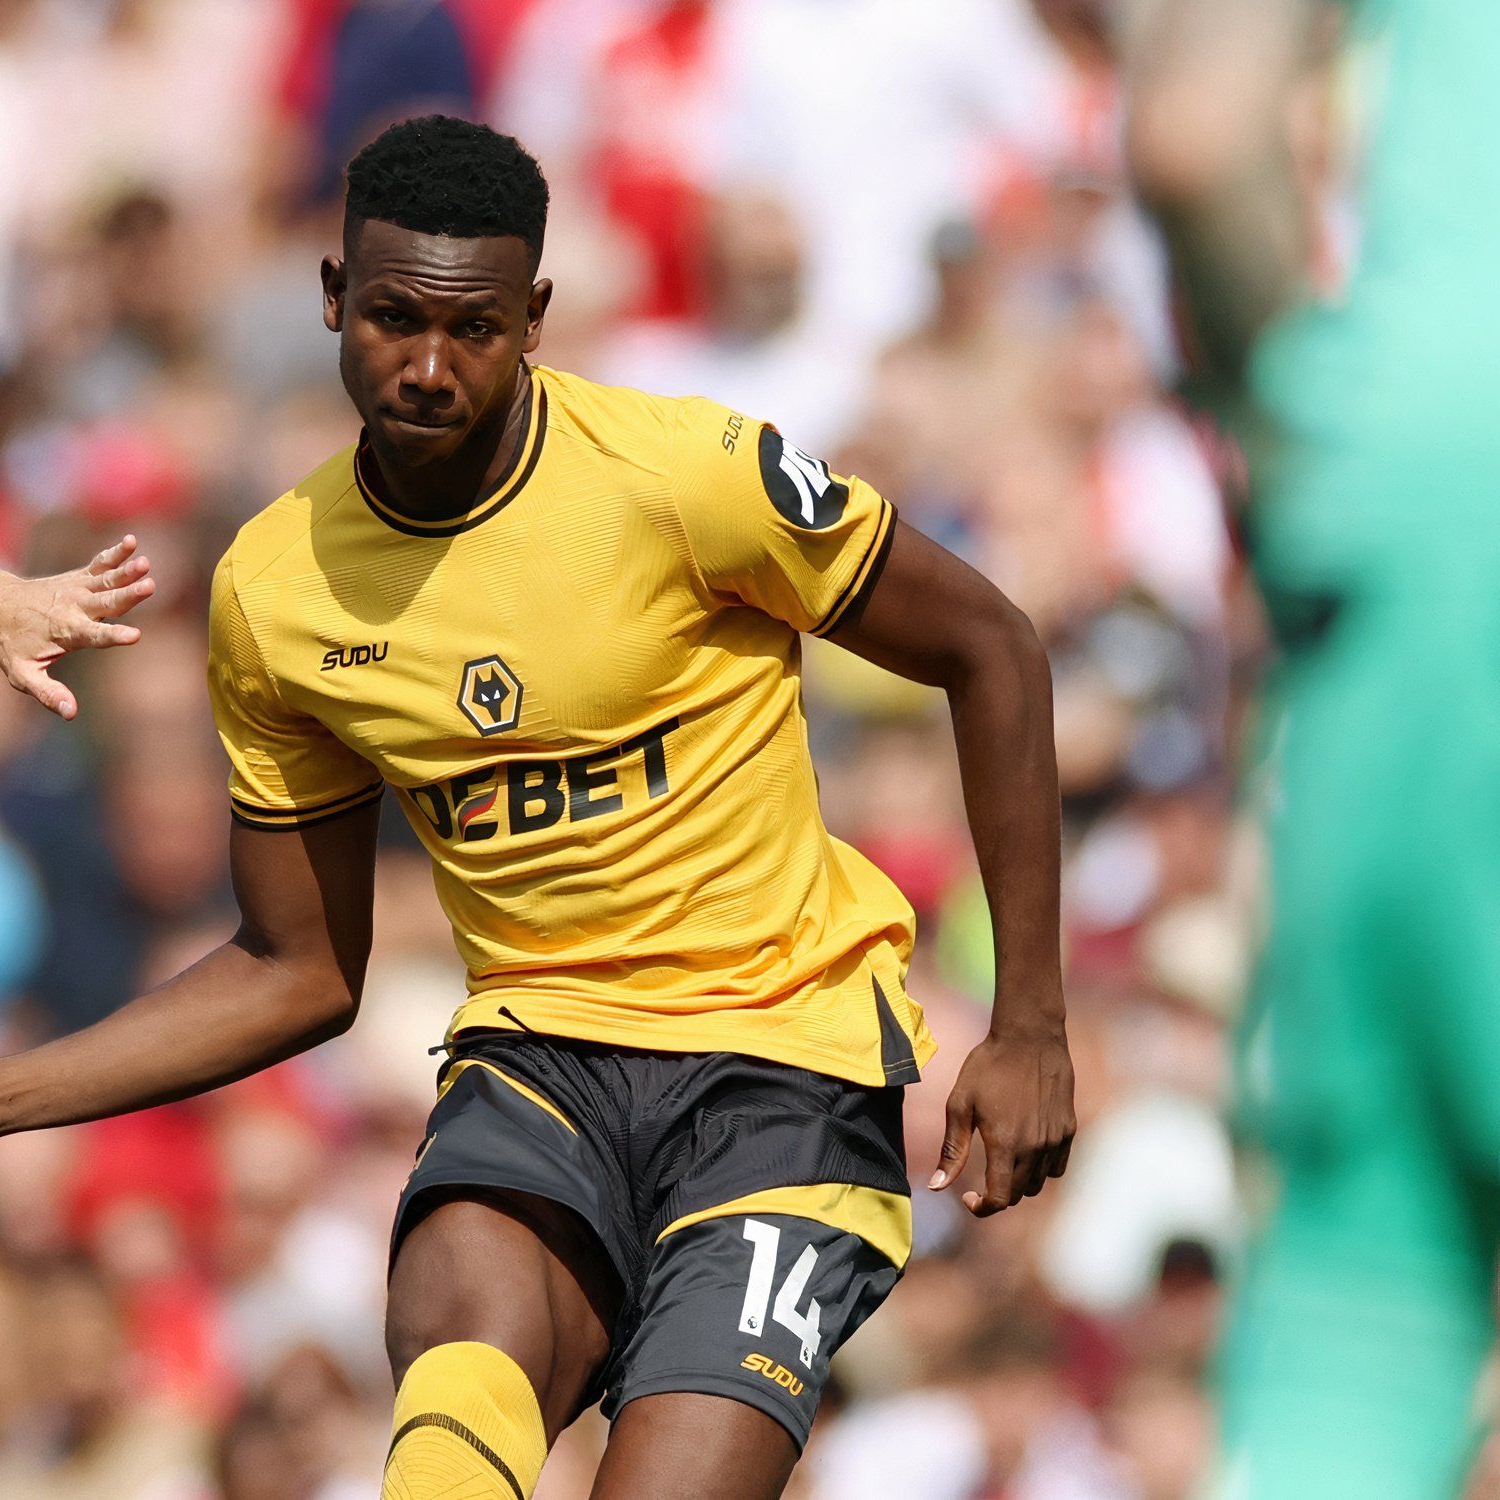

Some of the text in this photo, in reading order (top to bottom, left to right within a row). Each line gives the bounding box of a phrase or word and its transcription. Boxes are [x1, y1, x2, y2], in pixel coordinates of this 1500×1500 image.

[320, 641, 388, 671] SUDU
[406, 717, 679, 842] DEBET
[738, 1218, 822, 1369] 14
[740, 1352, 804, 1397] SUDU
